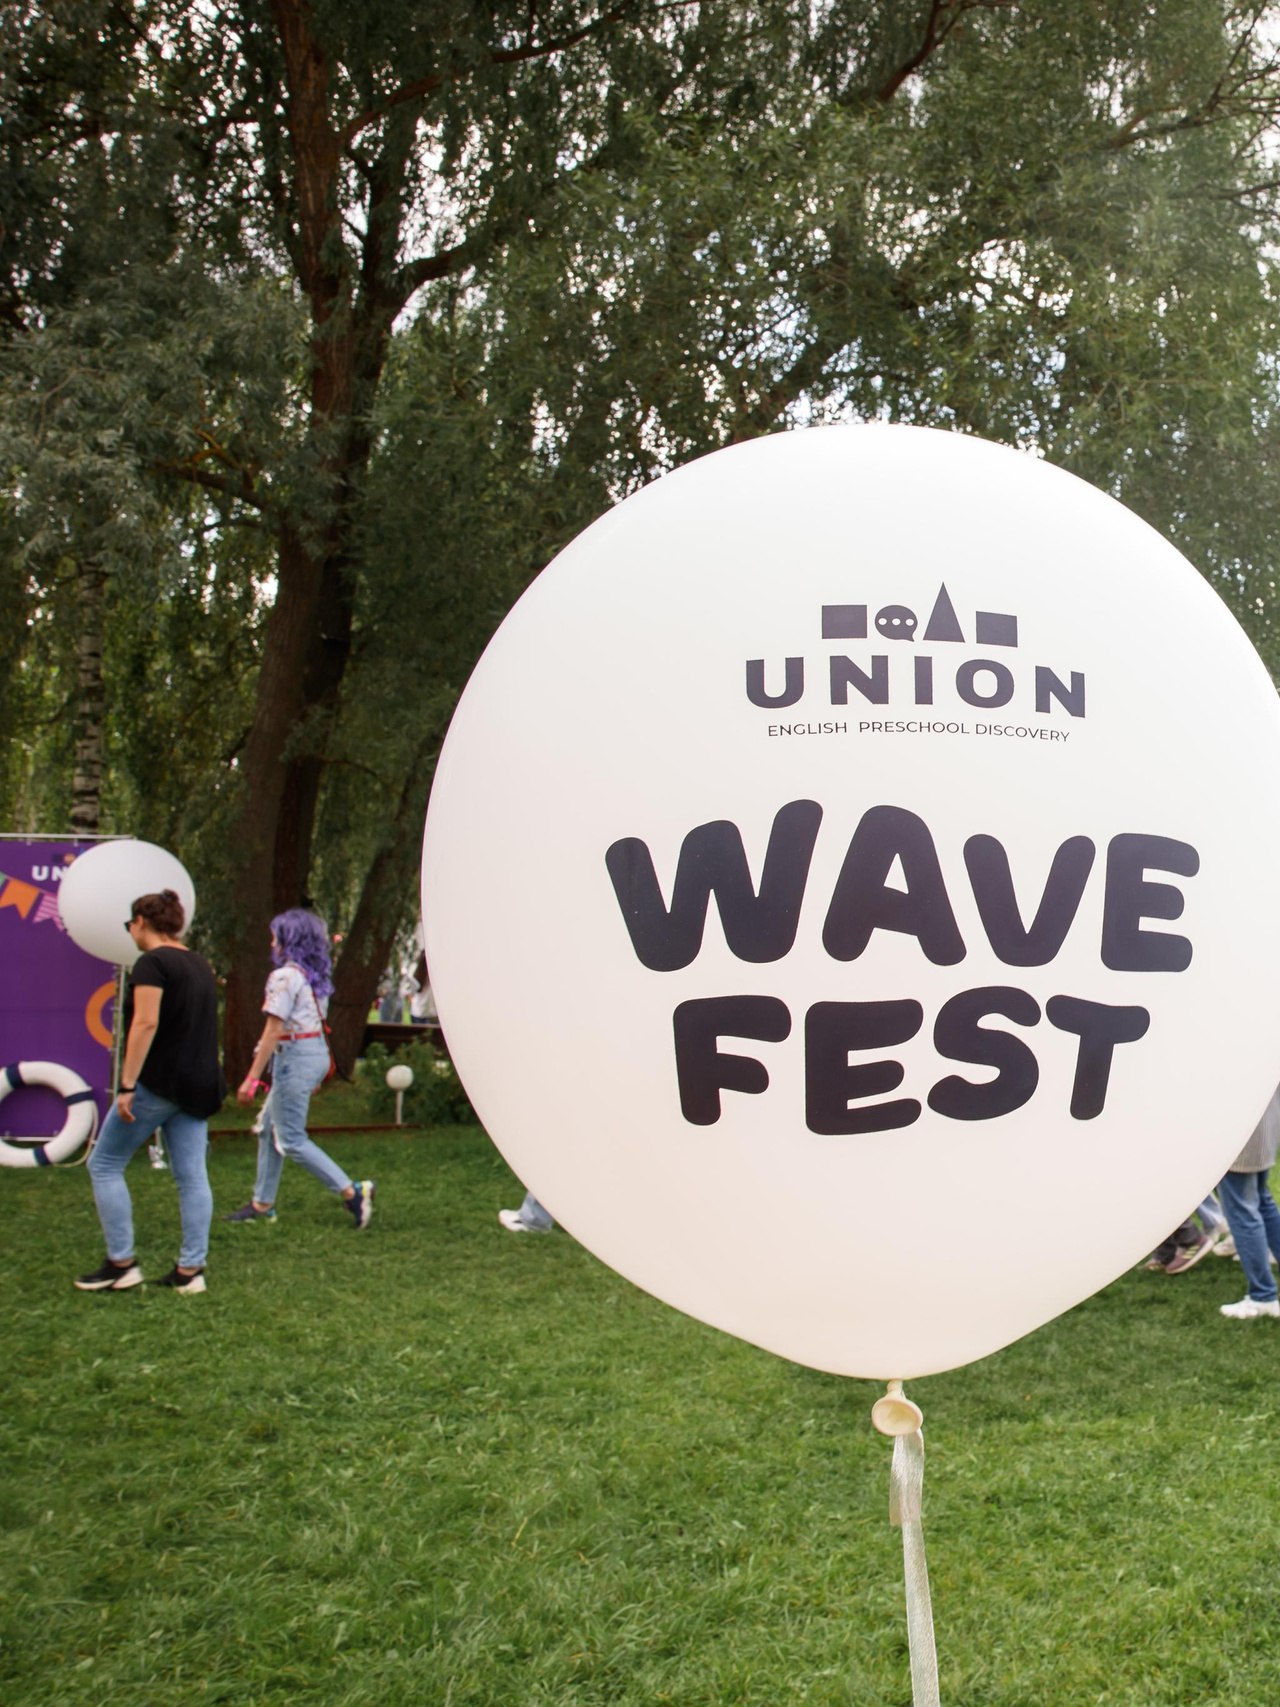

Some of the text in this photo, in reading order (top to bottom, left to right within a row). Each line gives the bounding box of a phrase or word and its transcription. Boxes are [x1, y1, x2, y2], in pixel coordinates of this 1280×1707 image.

[745, 654, 1086, 719] UNION
[767, 720, 1070, 743] ENGLISH PRESCHOOL DISCOVERY
[605, 798, 1200, 973] WAVE
[673, 985, 1150, 1136] FEST
